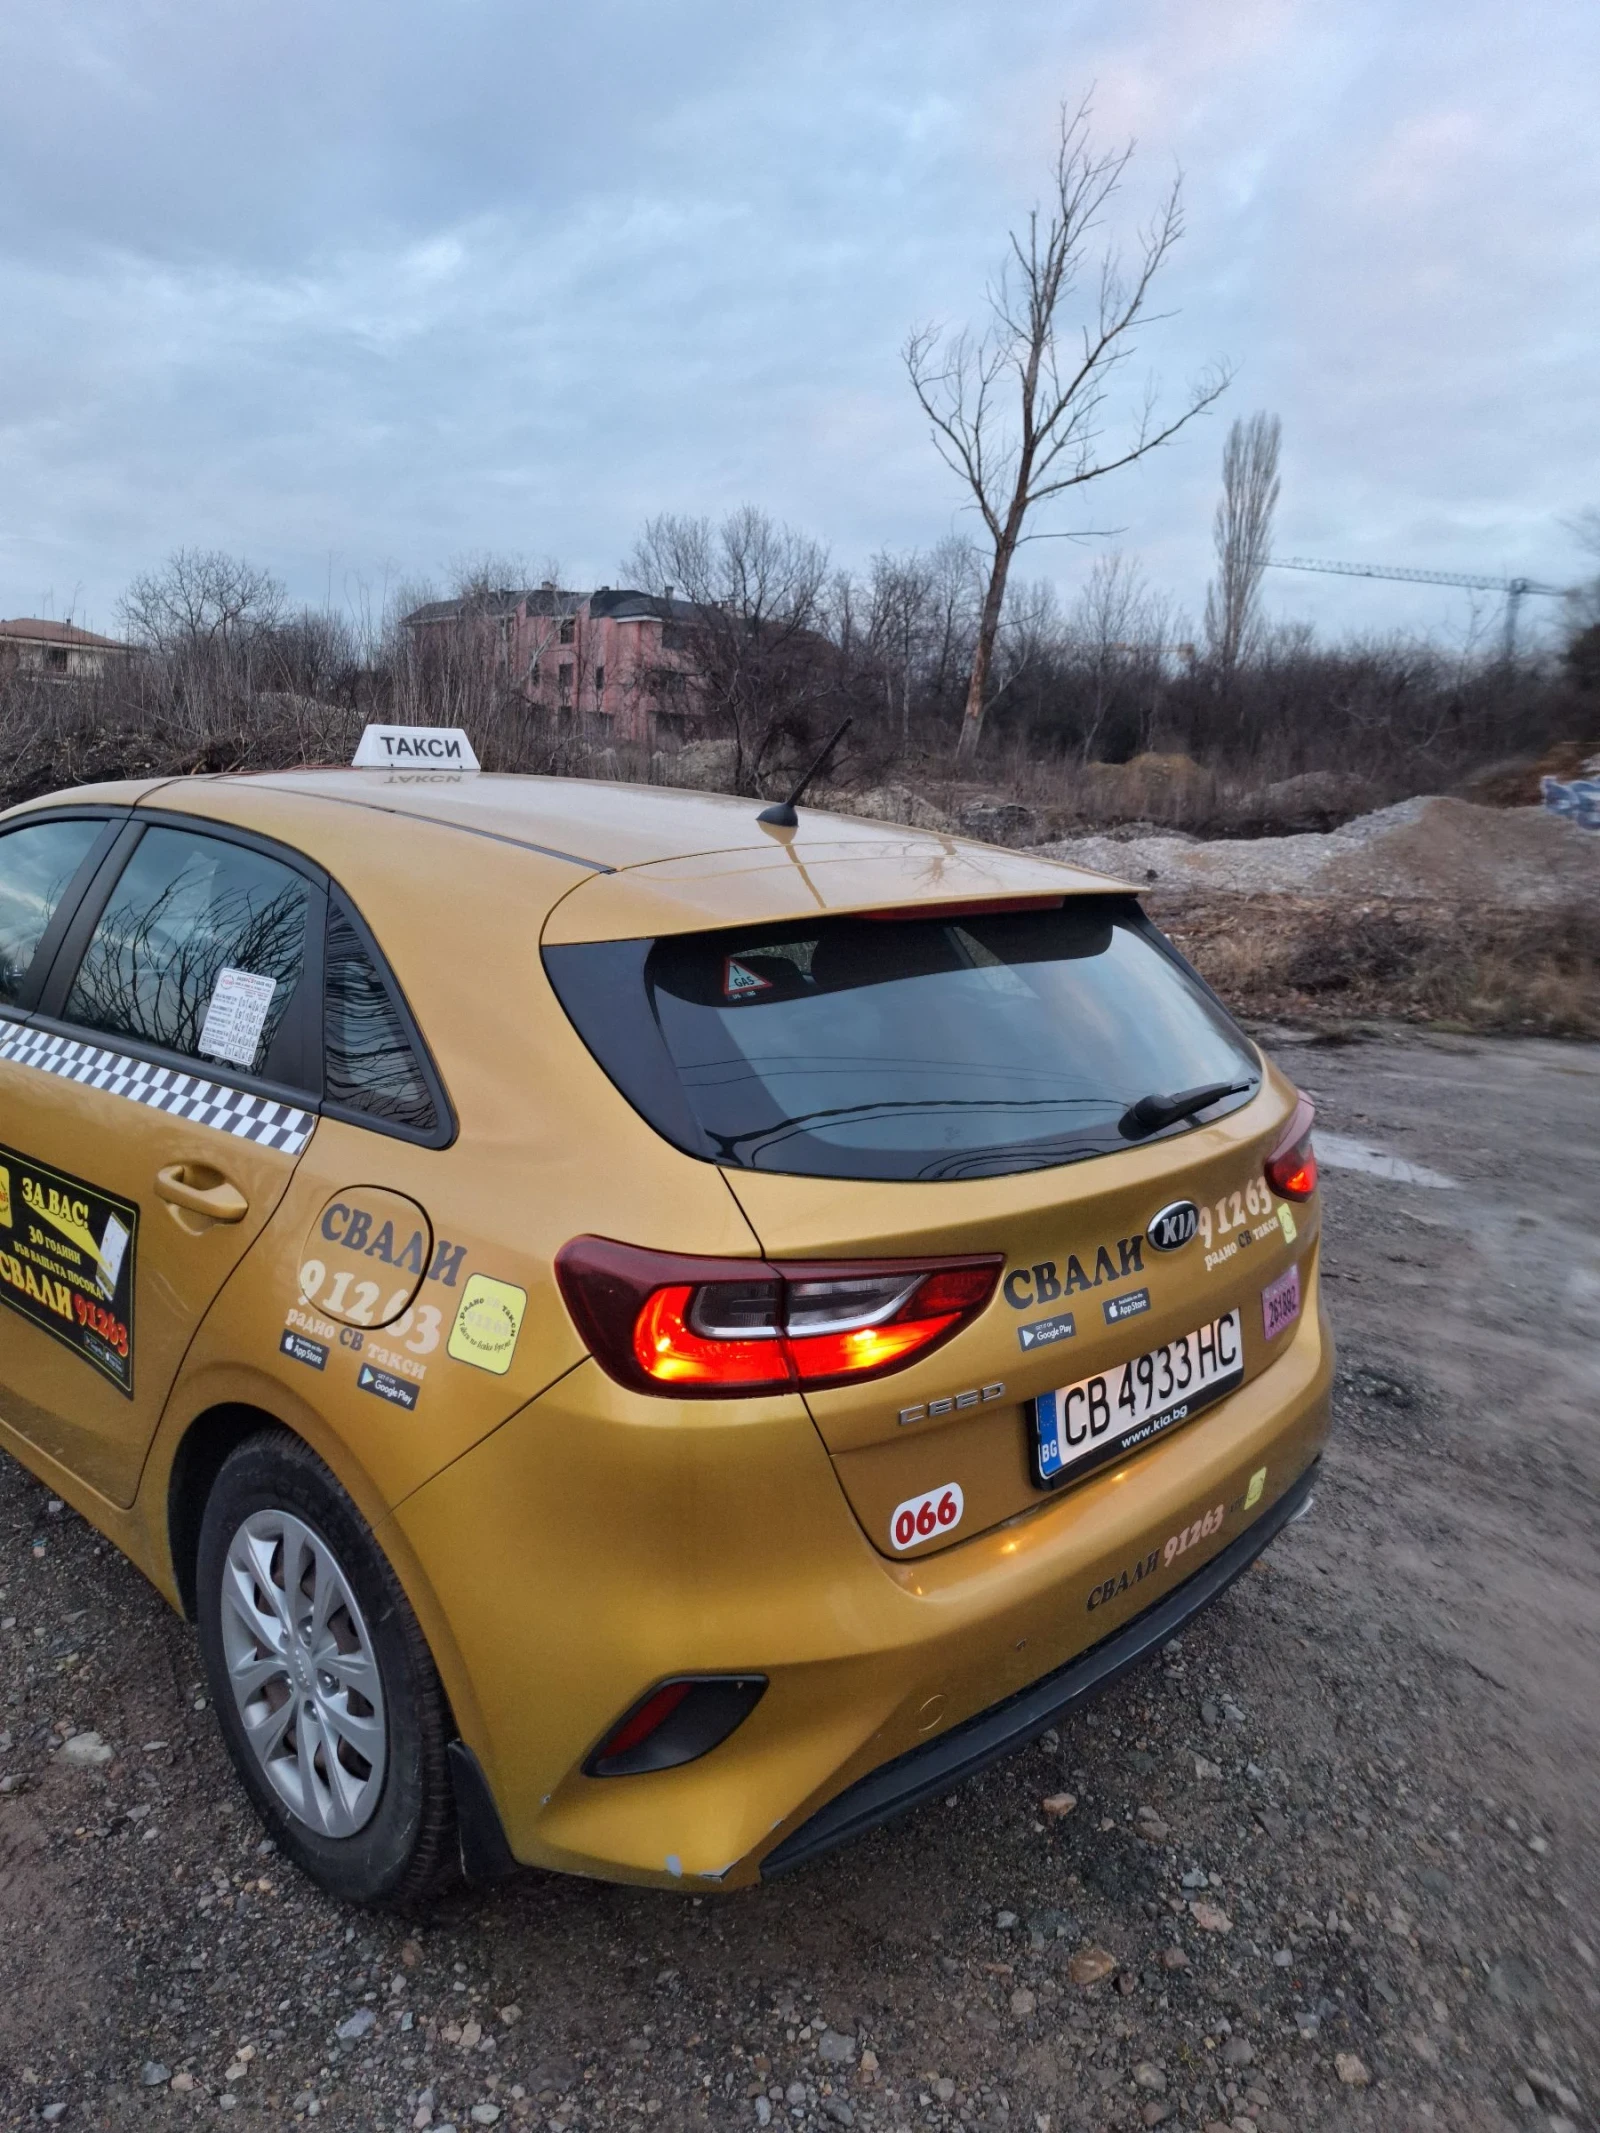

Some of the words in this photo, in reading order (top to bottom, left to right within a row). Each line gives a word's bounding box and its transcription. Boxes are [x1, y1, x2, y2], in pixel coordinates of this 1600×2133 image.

[380, 736, 462, 758] ТАКСИ
[734, 976, 755, 987] GAS
[22, 1177, 45, 1209] ЗА
[49, 1188, 89, 1230] ВАС!
[1198, 1175, 1272, 1249] 91263
[28, 1225, 44, 1245] 30
[45, 1236, 81, 1265] ГОДИНИ
[320, 1203, 468, 1287] СВАЛИ
[1161, 1209, 1198, 1245] KIA
[1204, 1242, 1237, 1272] радио
[1252, 1216, 1279, 1240] такси
[30, 1249, 67, 1279] ВАШАТА
[1003, 1235, 1144, 1310] СВАЛИ
[0, 1249, 74, 1322] СВАЛИ
[74, 1293, 128, 1357] 91263
[297, 1259, 443, 1355] 91263
[1119, 1304, 1131, 1315] App
[1131, 1299, 1147, 1311] Store
[285, 1308, 335, 1339] радио
[367, 1343, 427, 1380] такси
[1037, 1328, 1059, 1340] Google
[1059, 1324, 1072, 1334] Play
[293, 1345, 307, 1359] App
[306, 1350, 323, 1364] Store
[1118, 1336, 1192, 1417] 4933
[374, 1380, 398, 1398] Google
[398, 1389, 413, 1405] Play
[899, 1382, 1006, 1426] CEED
[1121, 1404, 1188, 1448] www.kia.bg
[1041, 1440, 1057, 1463] BG
[895, 1490, 957, 1545] 066
[1086, 1548, 1161, 1612] СВАЛИ
[1163, 1504, 1224, 1568] 91263
